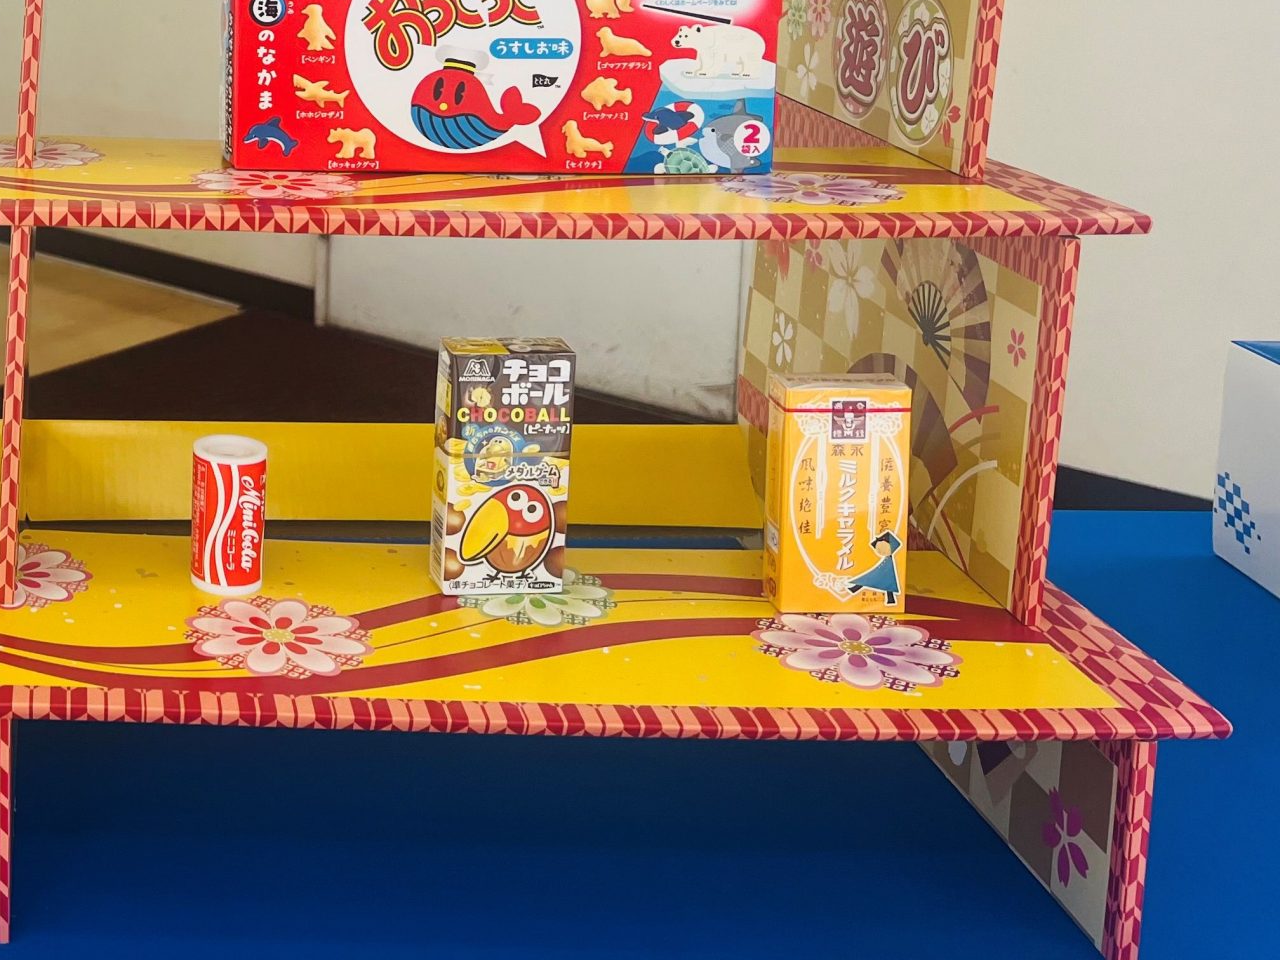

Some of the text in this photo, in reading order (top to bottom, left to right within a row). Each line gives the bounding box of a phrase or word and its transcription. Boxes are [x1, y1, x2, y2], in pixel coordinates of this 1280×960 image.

[496, 41, 570, 56] うすしお味
[743, 124, 761, 144] 2
[502, 359, 570, 382] チョコ
[501, 382, 570, 406] ボール
[457, 407, 570, 422] CHOCOBALL
[831, 444, 864, 457] 森永
[506, 463, 558, 478] メダルゲーム
[836, 460, 858, 571] ミルクキャラメル
